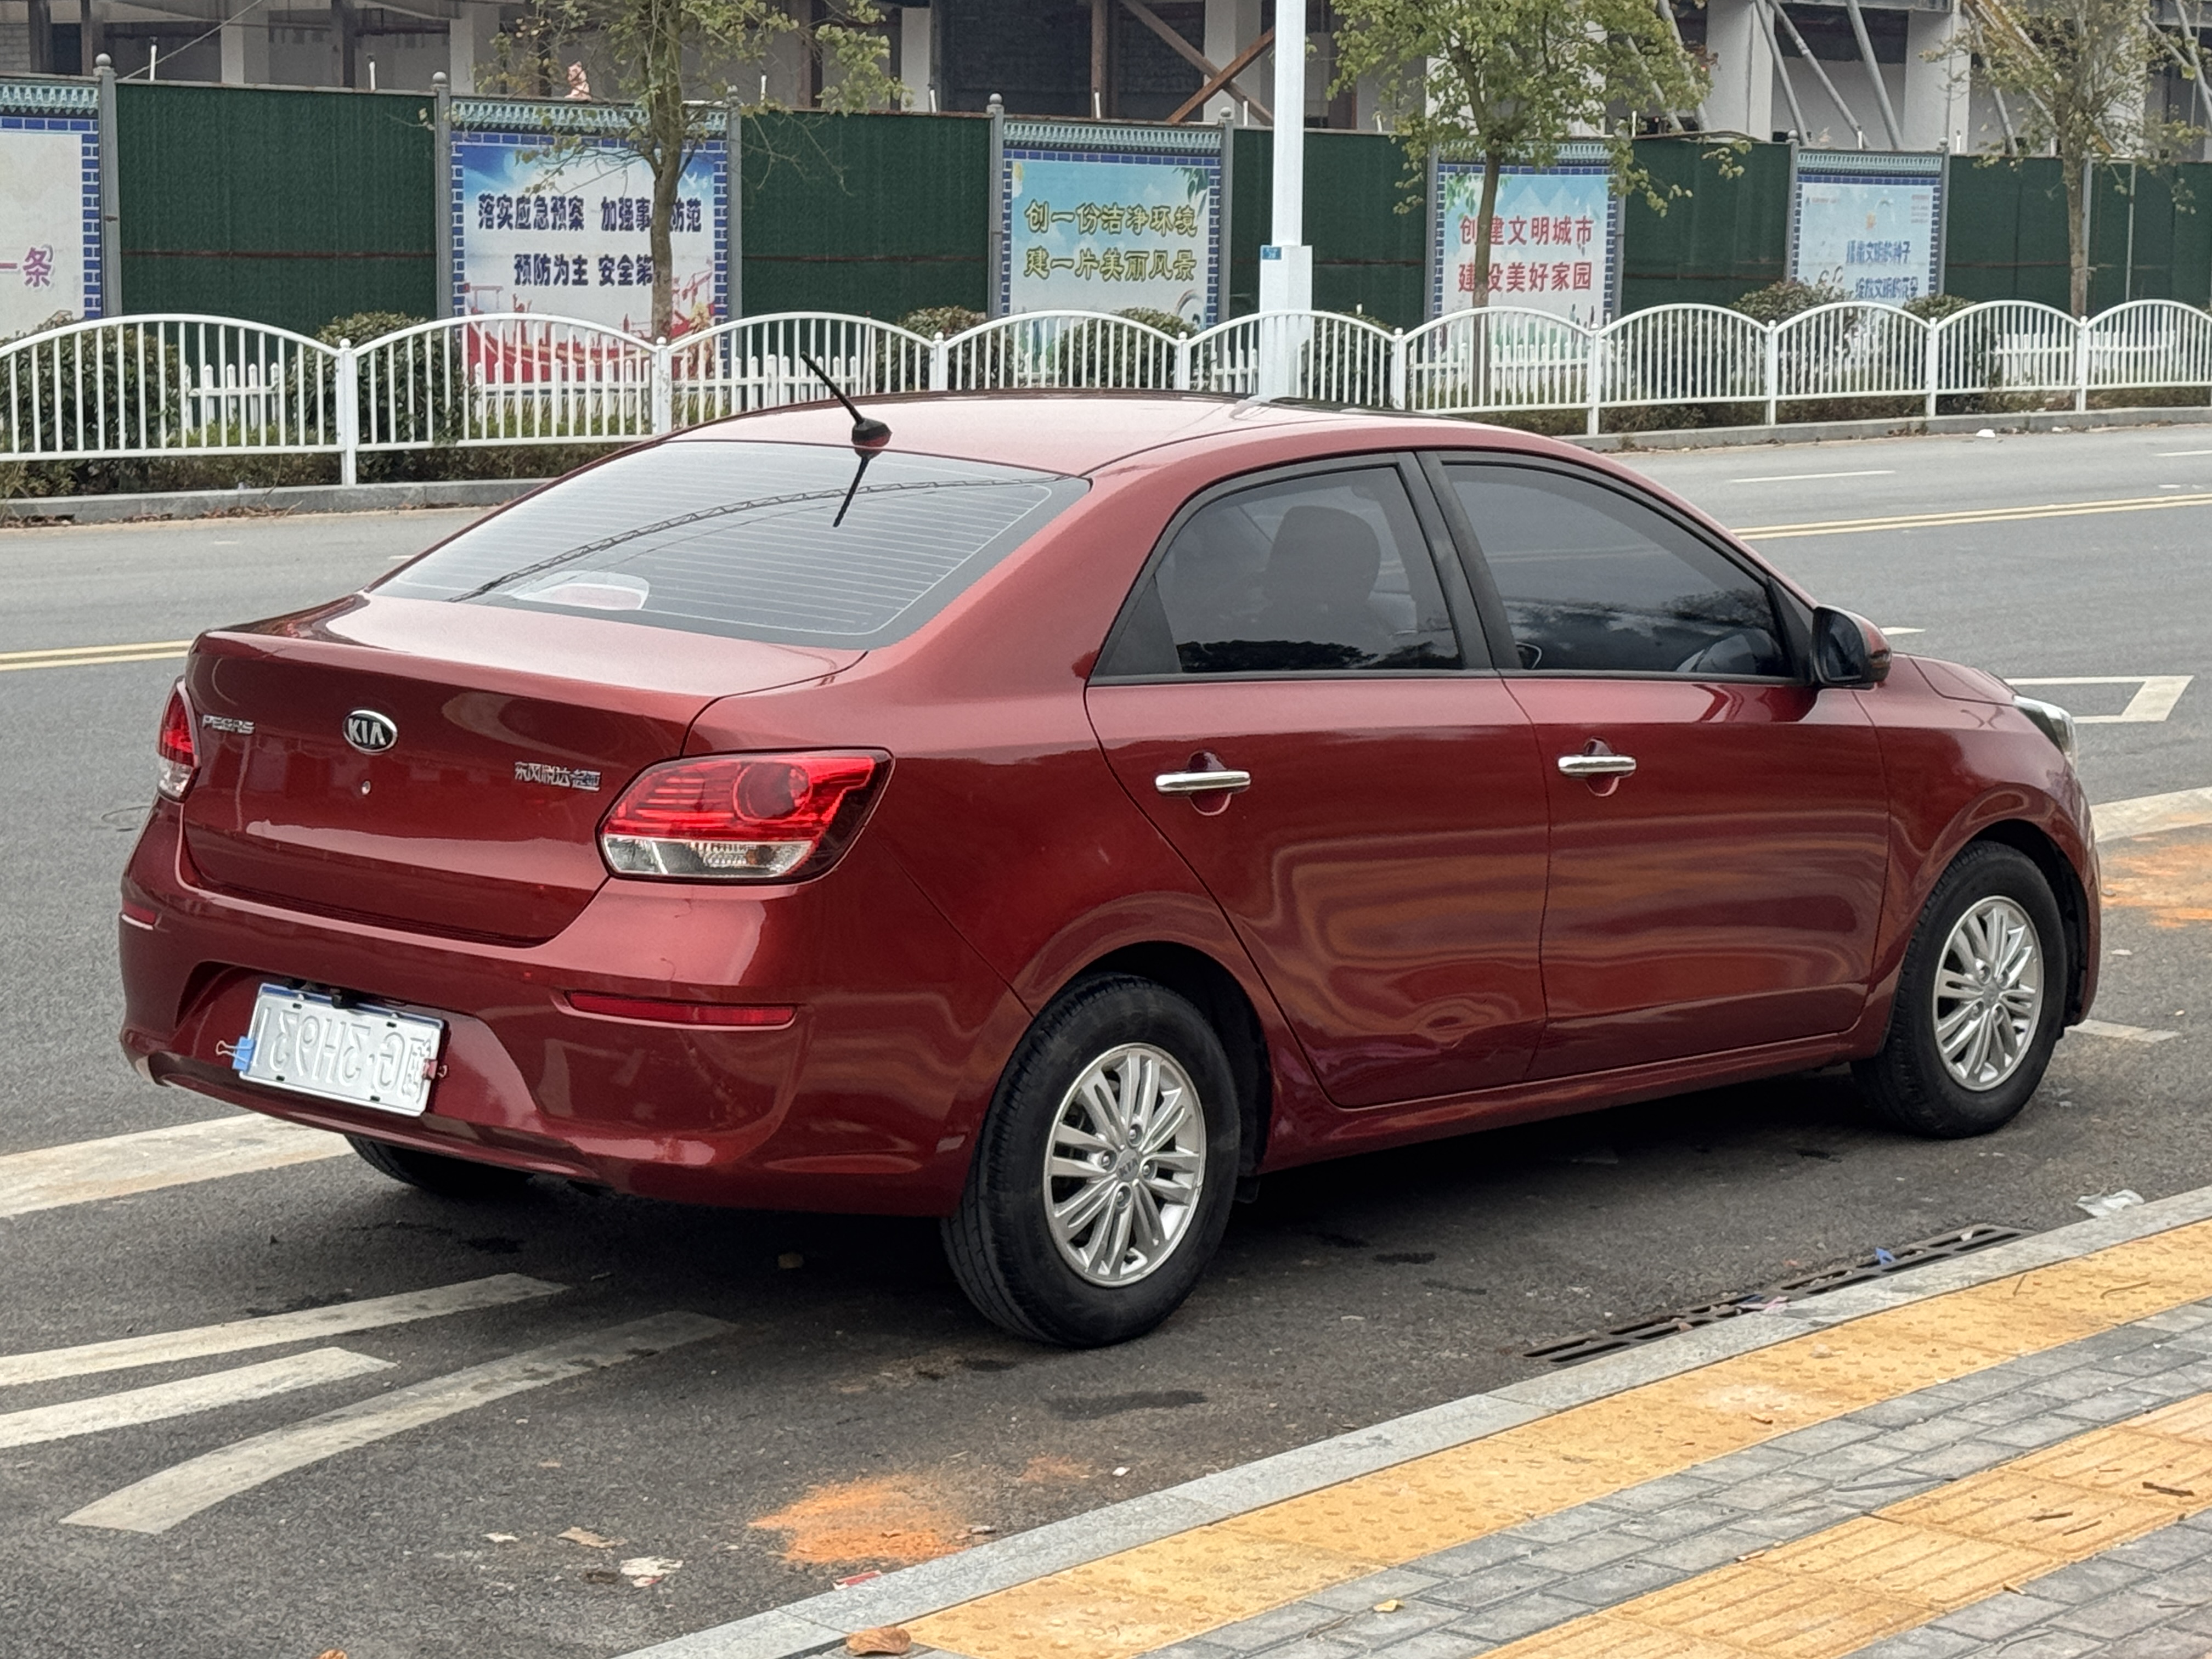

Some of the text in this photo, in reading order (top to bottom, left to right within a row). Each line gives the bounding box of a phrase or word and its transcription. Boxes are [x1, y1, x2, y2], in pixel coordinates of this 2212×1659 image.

[478, 193, 702, 233] 落实应急预案 加强事防范
[1024, 198, 1198, 238] 创一份洁净环境
[514, 253, 654, 286] 预防为主 安全第
[1024, 245, 1197, 282] 建一片美丽风景
[348, 718, 387, 746] KIA
